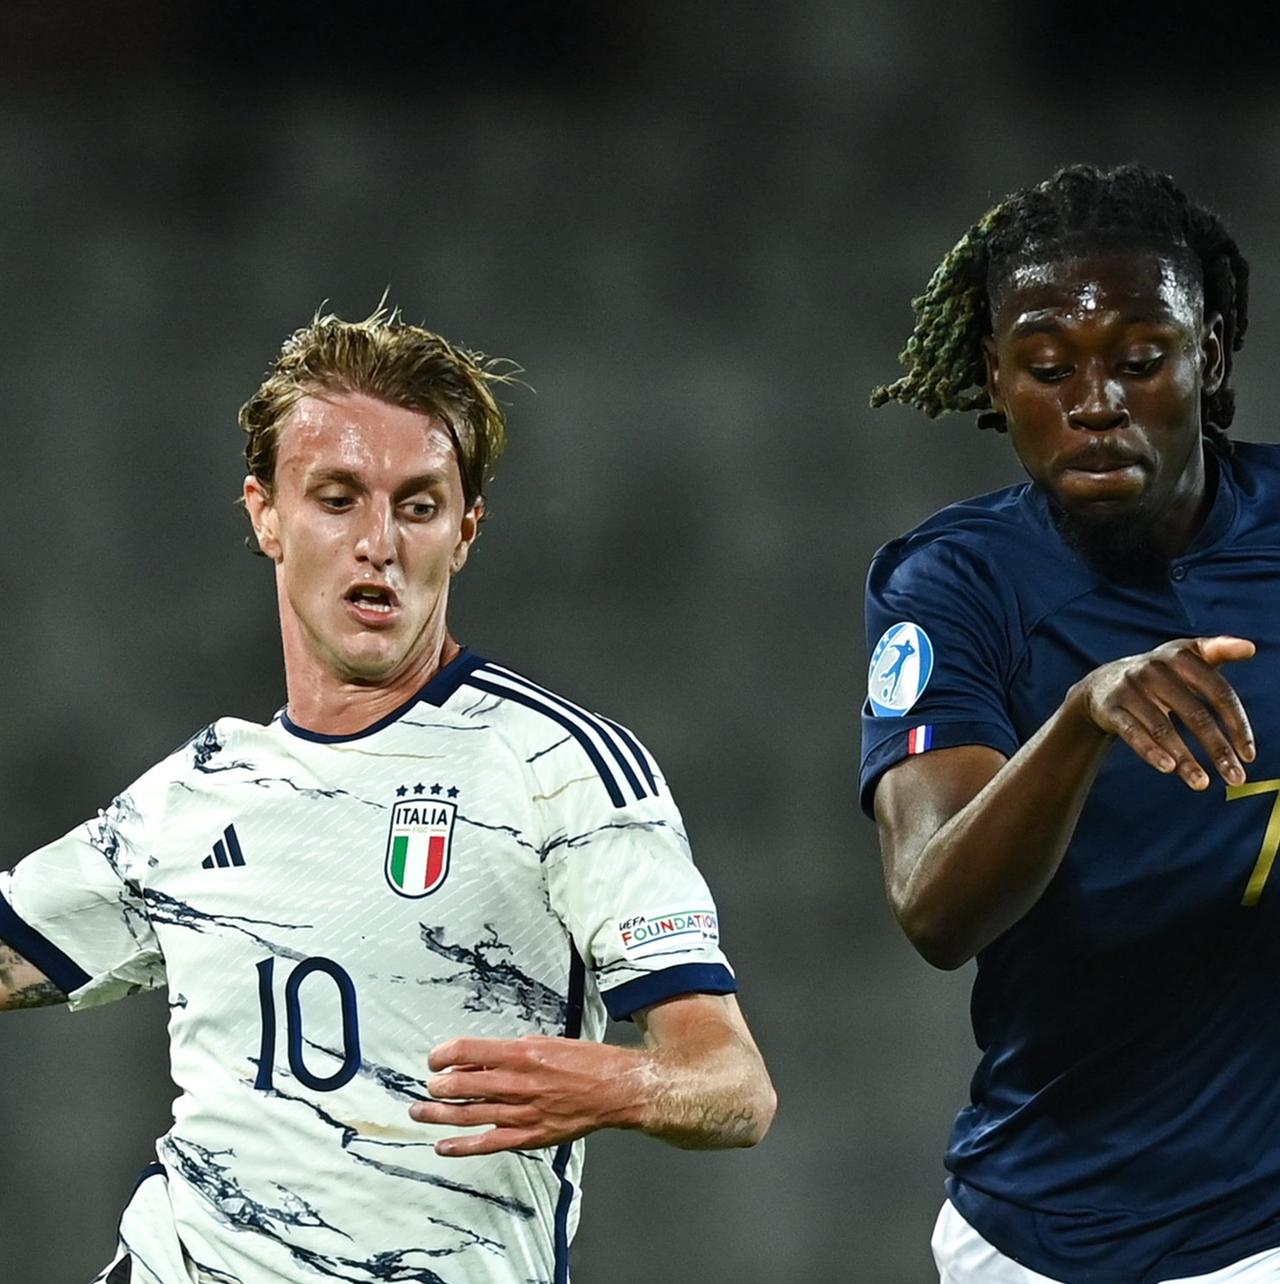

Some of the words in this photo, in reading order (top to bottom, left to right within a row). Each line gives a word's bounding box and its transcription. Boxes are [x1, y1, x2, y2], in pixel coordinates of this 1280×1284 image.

[396, 808, 448, 826] ITALIA
[619, 916, 646, 931] UEFA
[254, 956, 362, 1092] 10
